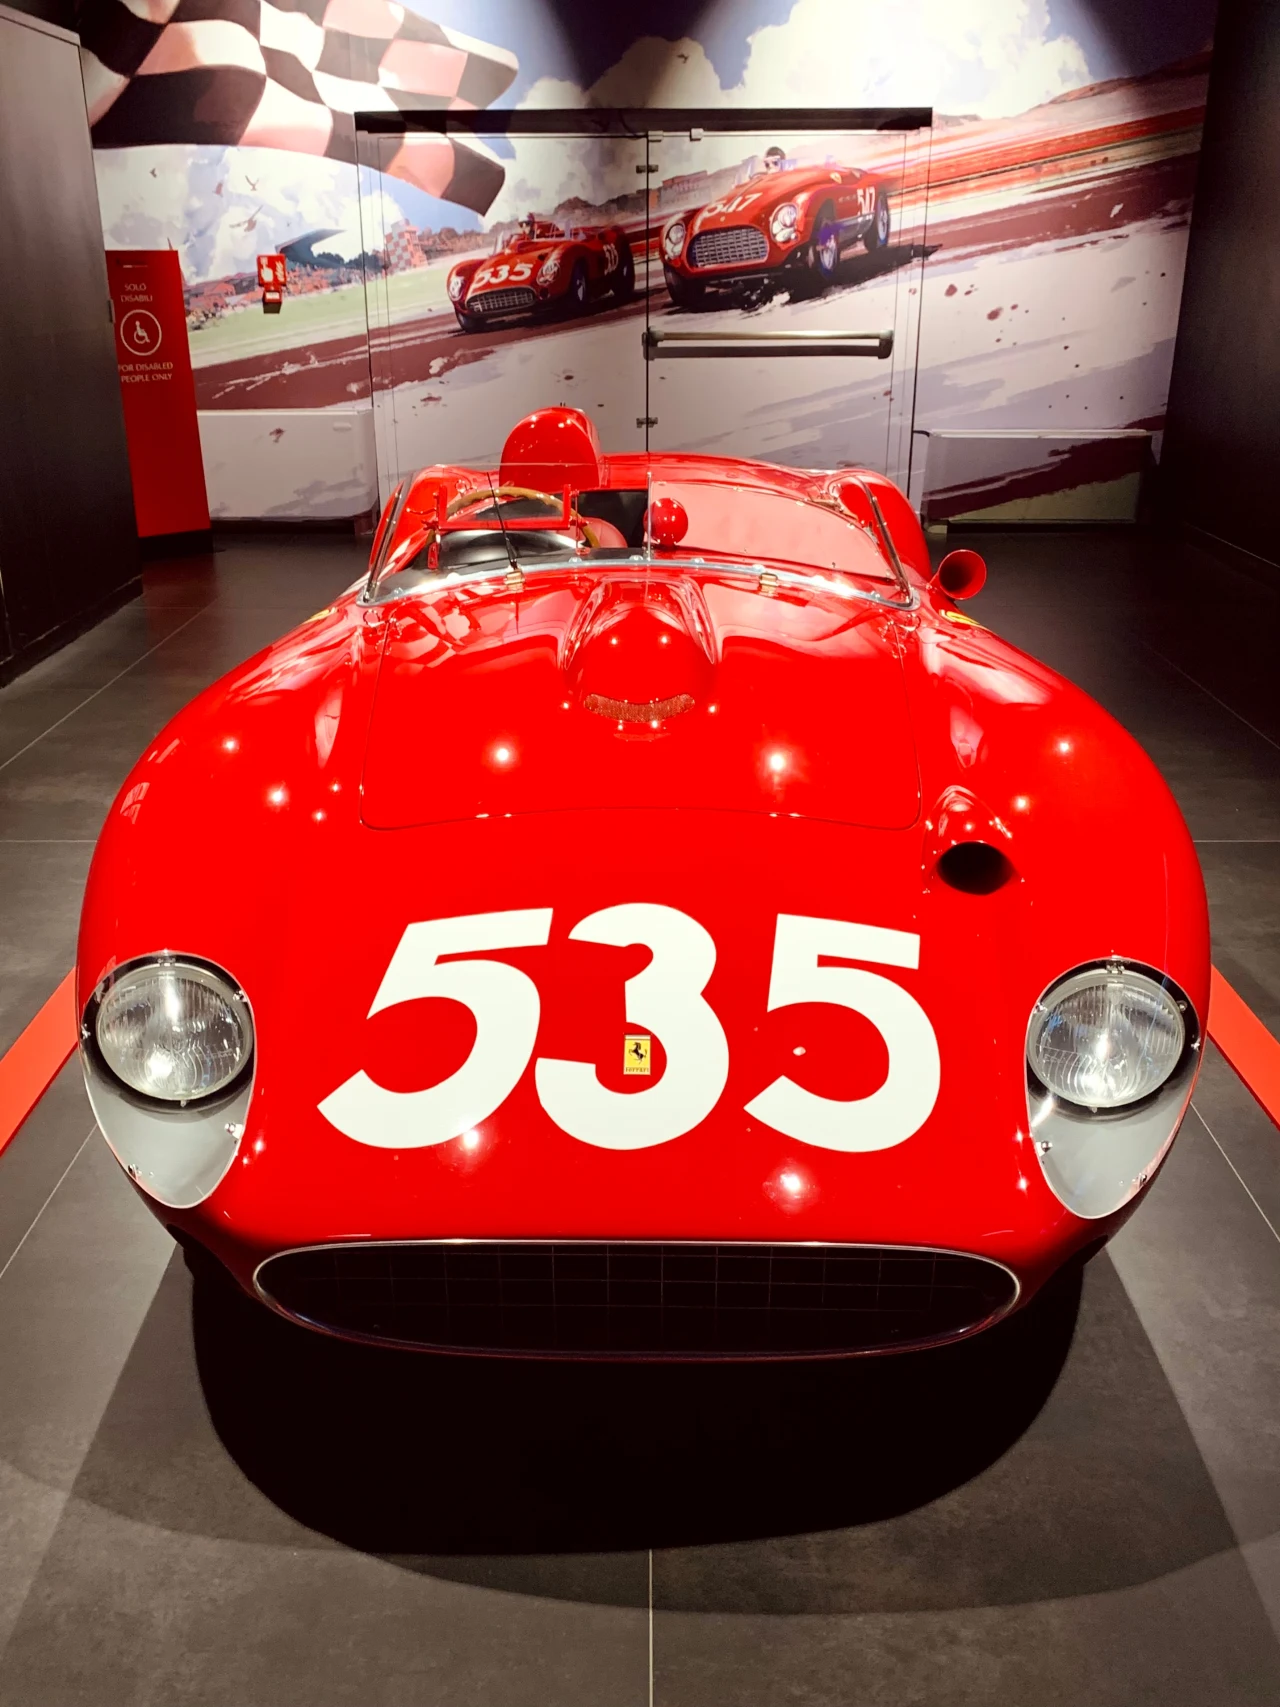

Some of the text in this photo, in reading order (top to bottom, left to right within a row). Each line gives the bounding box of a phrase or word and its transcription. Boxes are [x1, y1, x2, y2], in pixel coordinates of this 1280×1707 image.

[474, 263, 533, 288] 535
[124, 283, 147, 291] SOLO
[135, 362, 174, 371] DISABLED
[121, 373, 173, 383] PEOPLE ONLY
[317, 902, 941, 1153] 535
